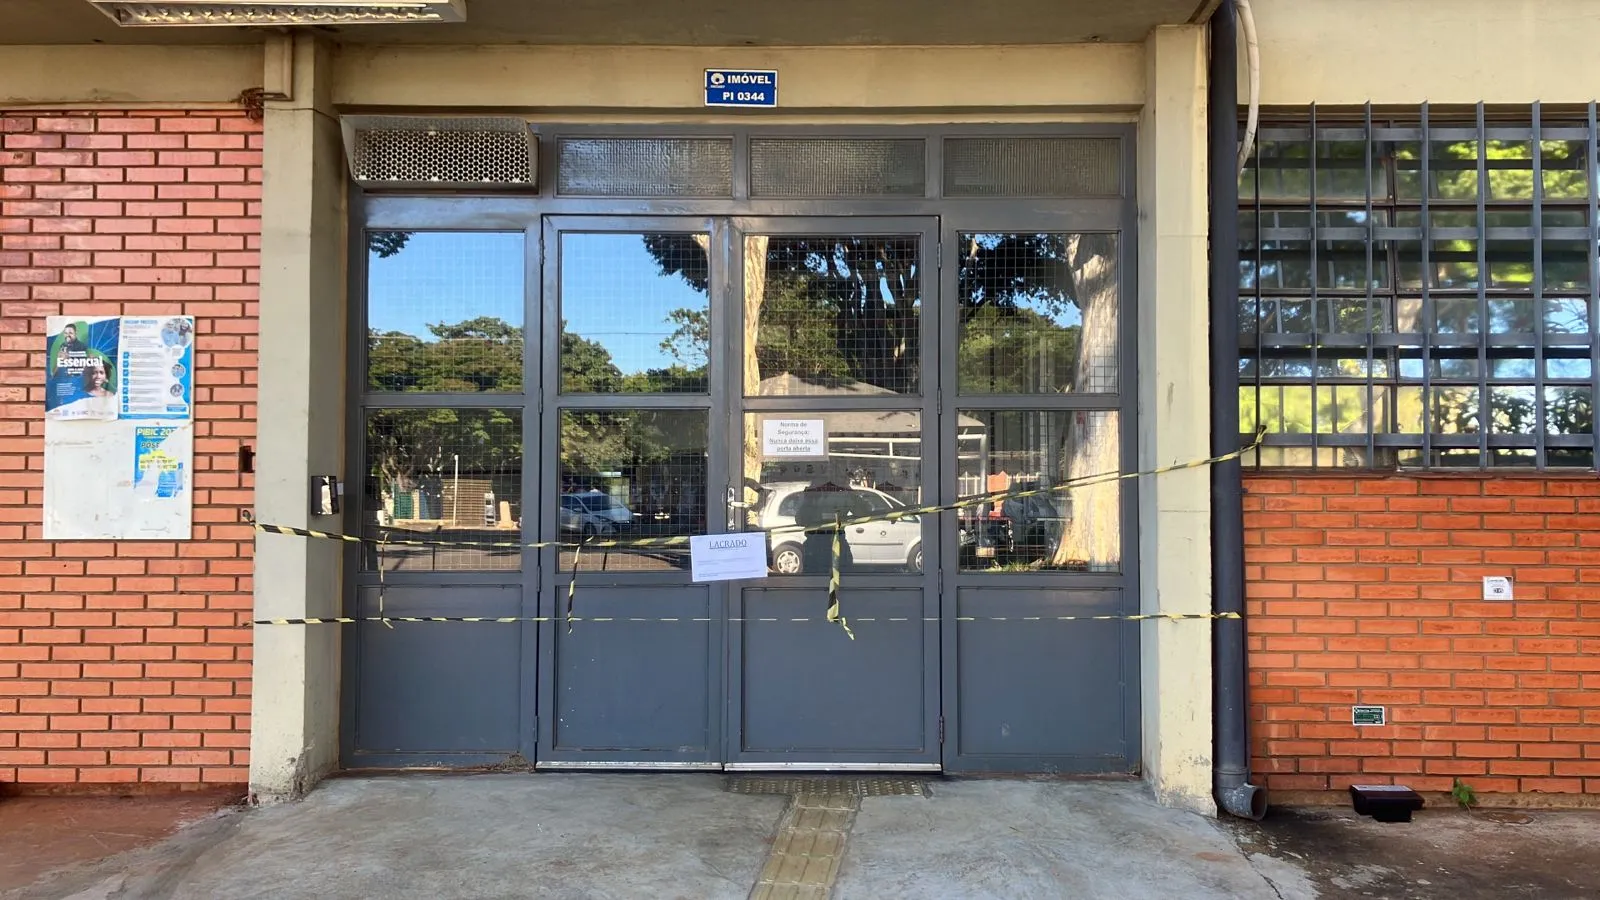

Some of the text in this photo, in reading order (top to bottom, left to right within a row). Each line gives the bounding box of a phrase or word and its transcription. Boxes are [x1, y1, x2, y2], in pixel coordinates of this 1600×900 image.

[728, 73, 771, 84] IMÓVEL
[723, 92, 765, 101] PI 0344
[57, 356, 103, 368] Essencial
[137, 428, 159, 436] PIBIC
[709, 539, 747, 549] LACRADO
